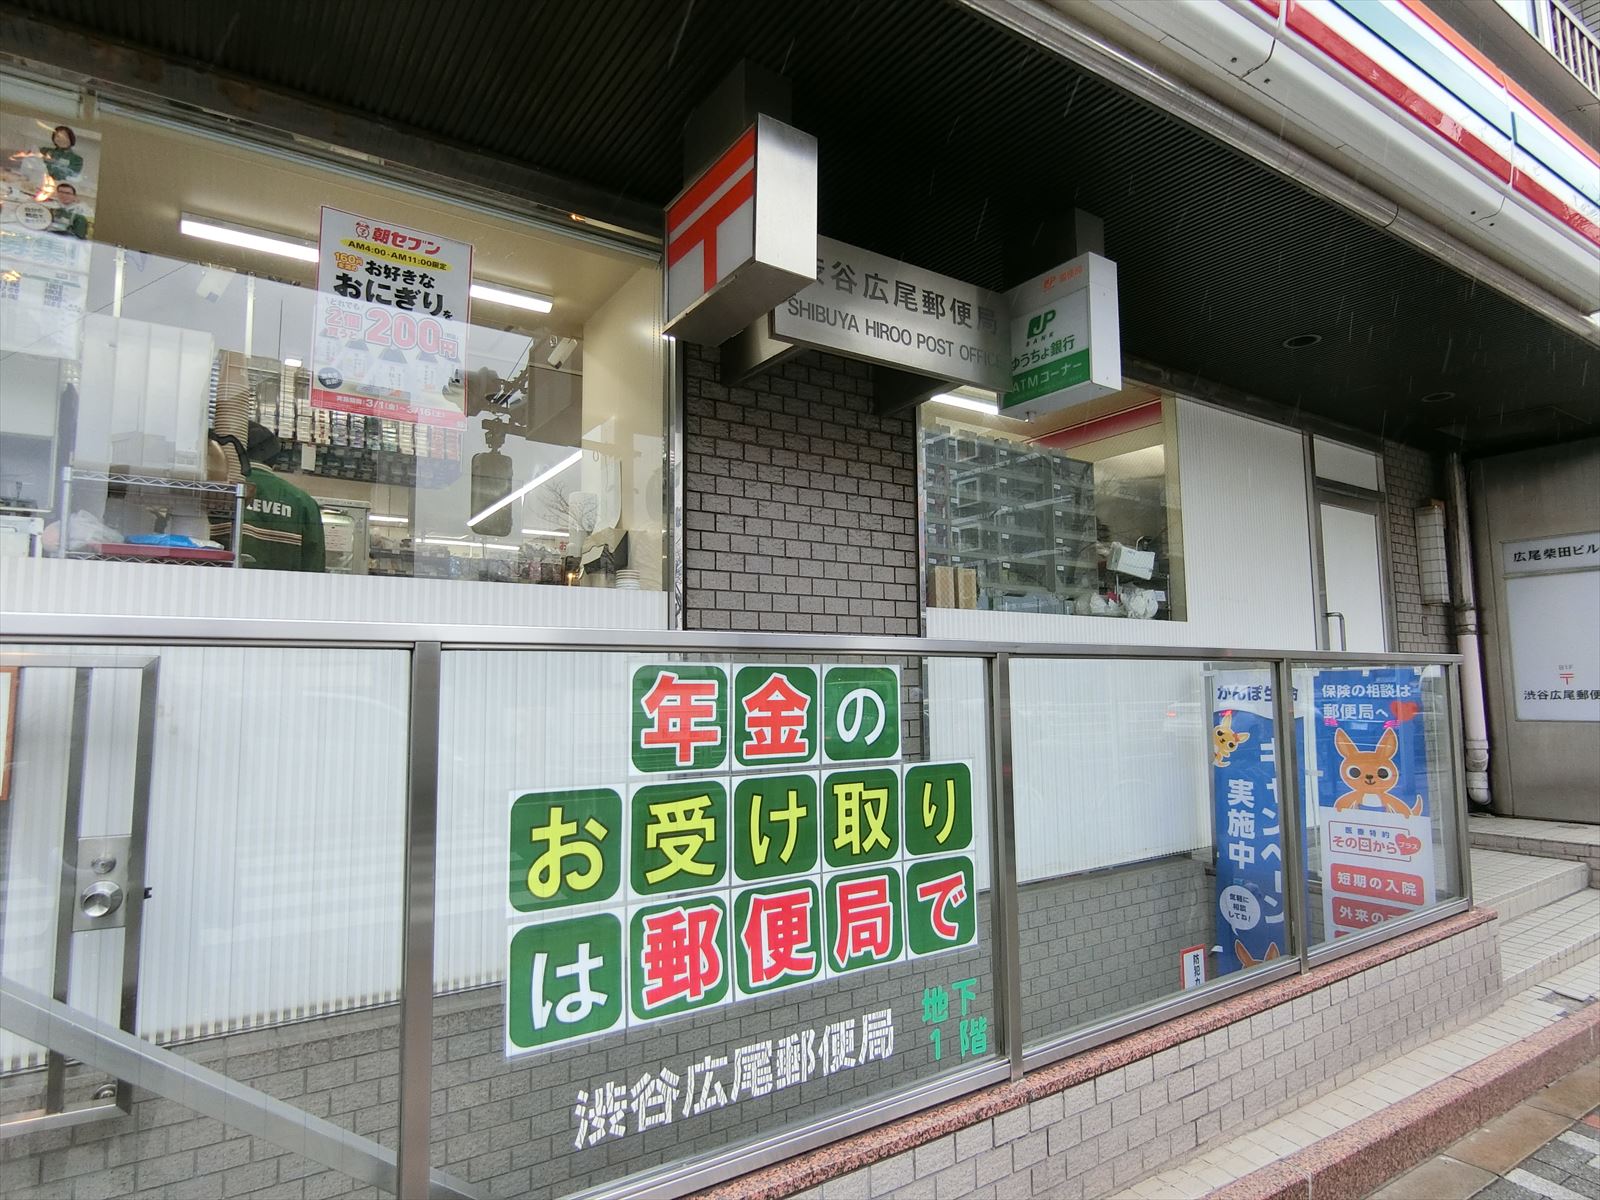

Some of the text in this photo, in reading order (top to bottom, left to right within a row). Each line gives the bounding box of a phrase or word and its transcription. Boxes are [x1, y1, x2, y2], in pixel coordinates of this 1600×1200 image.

[372, 226, 441, 255] 朝セブン
[333, 272, 453, 319] おにぎりを
[365, 260, 435, 289] お好きな
[365, 307, 458, 360] 200円
[787, 297, 859, 333] SHIBUYA
[865, 317, 913, 347] HIROO
[916, 333, 954, 358] POST
[1027, 309, 1056, 339] JP
[1011, 334, 1075, 371] ゆうちょ銀行
[1012, 362, 1083, 393] ATMコーナー
[1513, 543, 1600, 563] 広尾柴田ビル
[1321, 684, 1411, 698] 保険の相談は
[1323, 703, 1389, 719] 郵便局へ
[640, 670, 887, 765] 年金の
[525, 777, 956, 901] お受け取り
[1227, 778, 1256, 870] 実施中
[1337, 871, 1417, 897] 短期の入院
[531, 869, 967, 1031] は郵便局で
[921, 977, 977, 1025] 地下
[929, 1016, 989, 1061] 1階
[573, 1007, 895, 1151] 渋谷広尾郵便局
